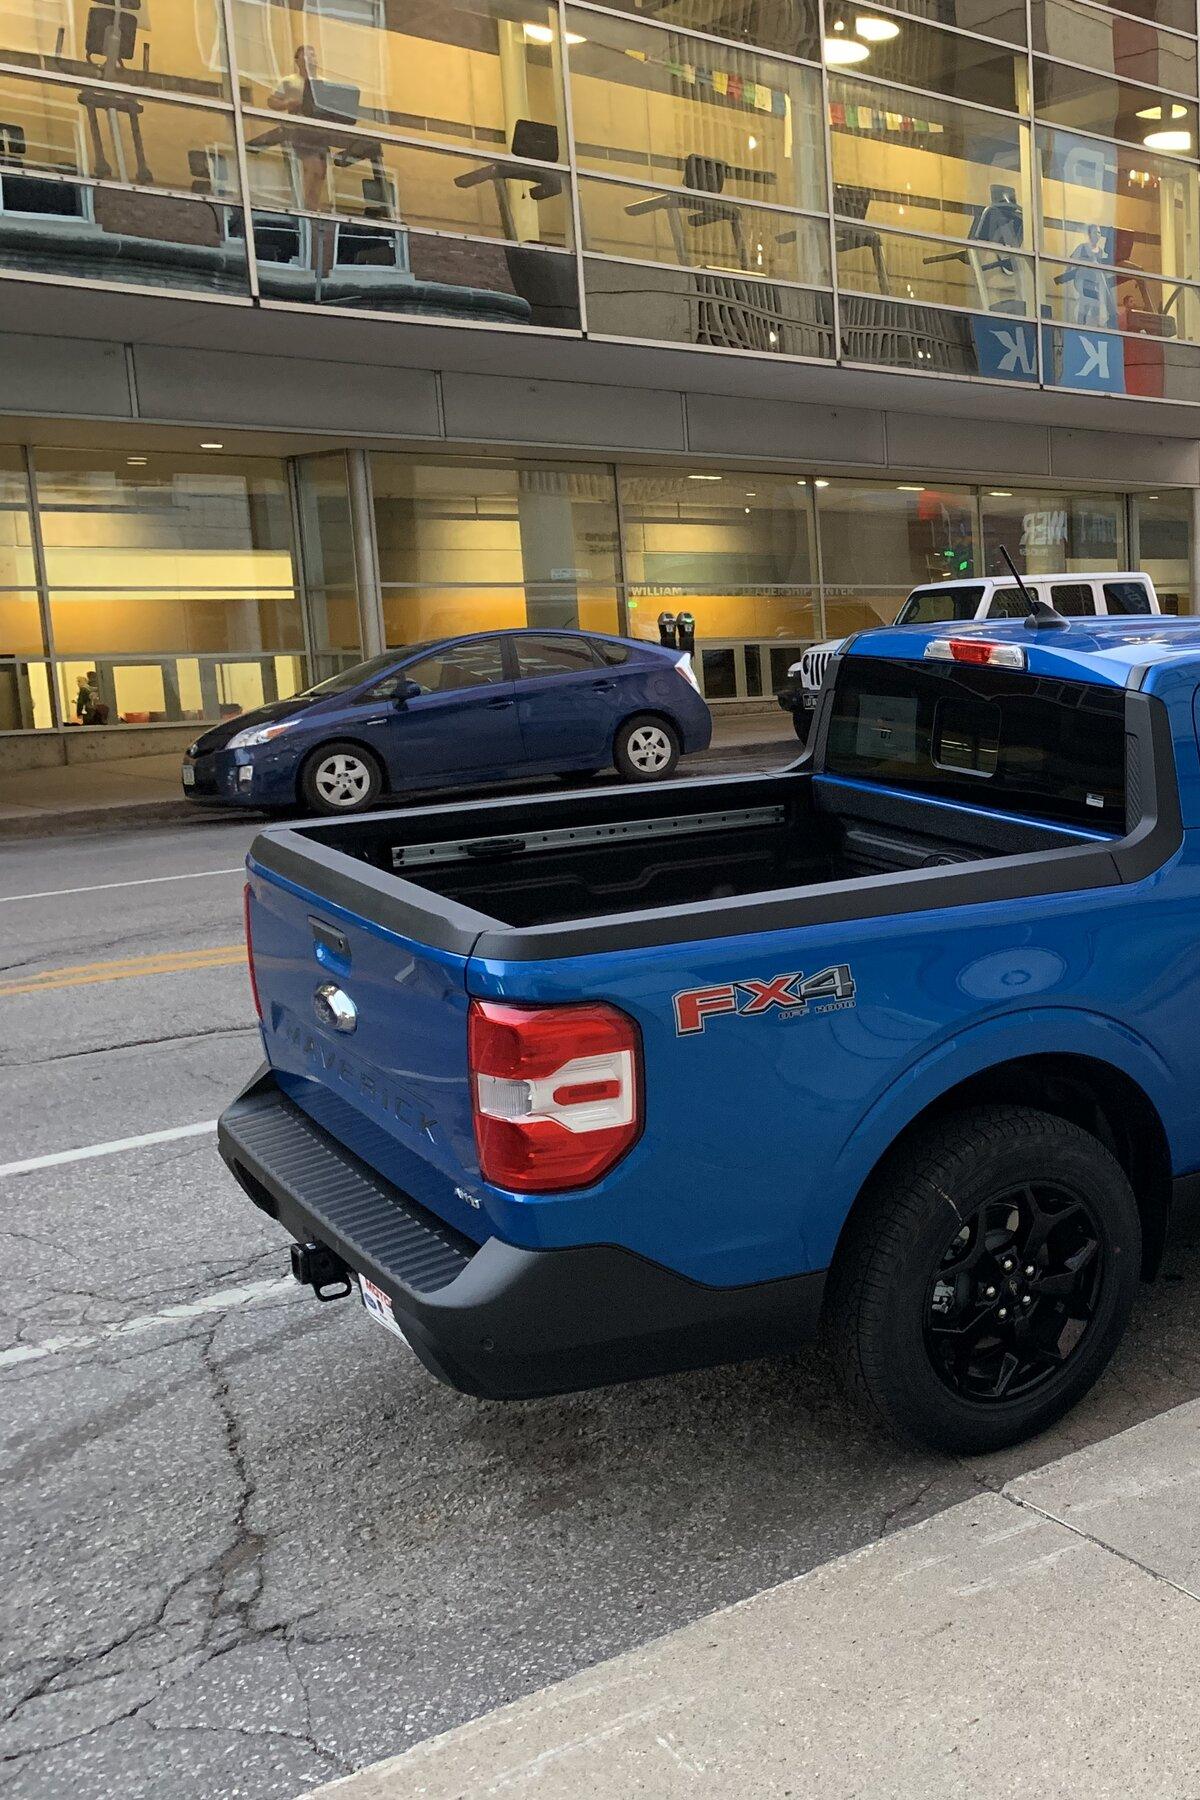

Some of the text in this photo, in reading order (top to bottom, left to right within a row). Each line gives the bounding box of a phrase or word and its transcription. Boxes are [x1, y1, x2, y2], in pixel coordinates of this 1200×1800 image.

[631, 586, 682, 596] WILLIAM
[672, 964, 856, 1037] FX4
[778, 1001, 856, 1020] OFF ROAD
[286, 1024, 438, 1145] MAVERICK
